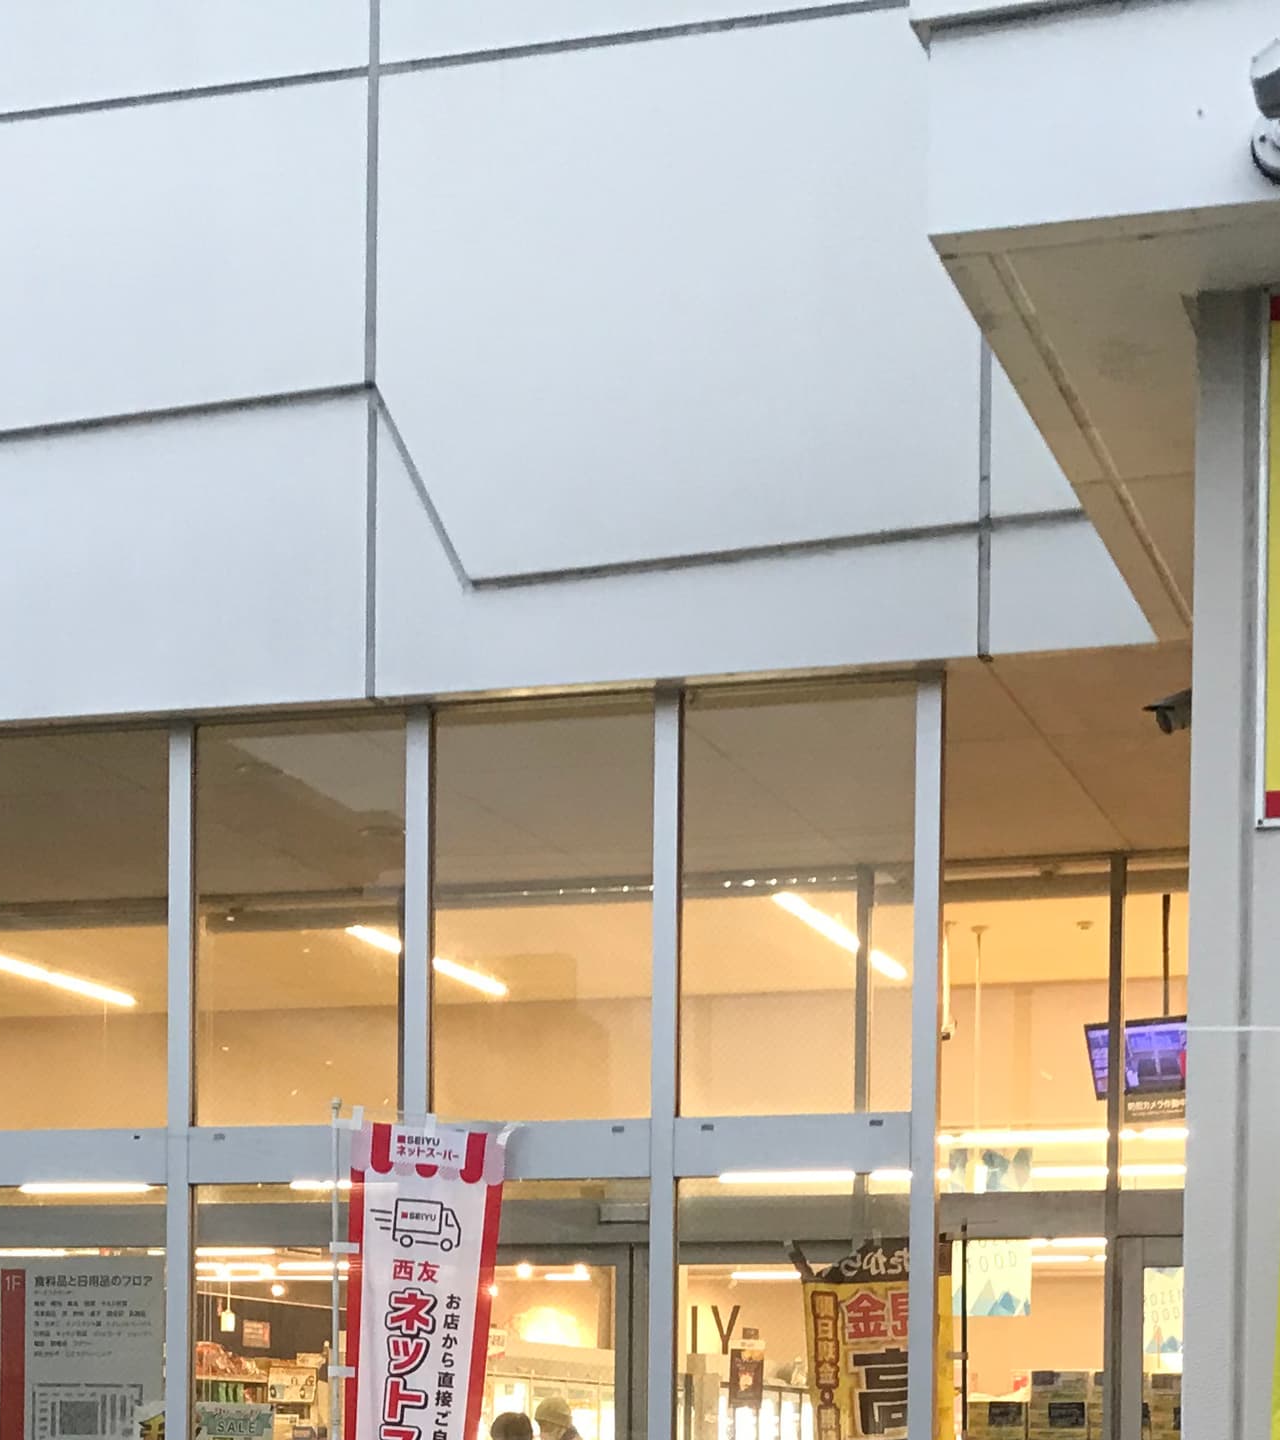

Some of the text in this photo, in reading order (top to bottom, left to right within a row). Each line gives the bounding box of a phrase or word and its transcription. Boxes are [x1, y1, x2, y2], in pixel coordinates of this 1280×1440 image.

[407, 1135, 440, 1147] SEIYU
[396, 1145, 460, 1161] ネットスーパー
[409, 1211, 436, 1222] SEIYU
[392, 1258, 441, 1283] 西友
[5, 1275, 21, 1291] 1F
[34, 1275, 153, 1288] 食料品と日用品のフロア
[217, 1421, 255, 1433] SALE
